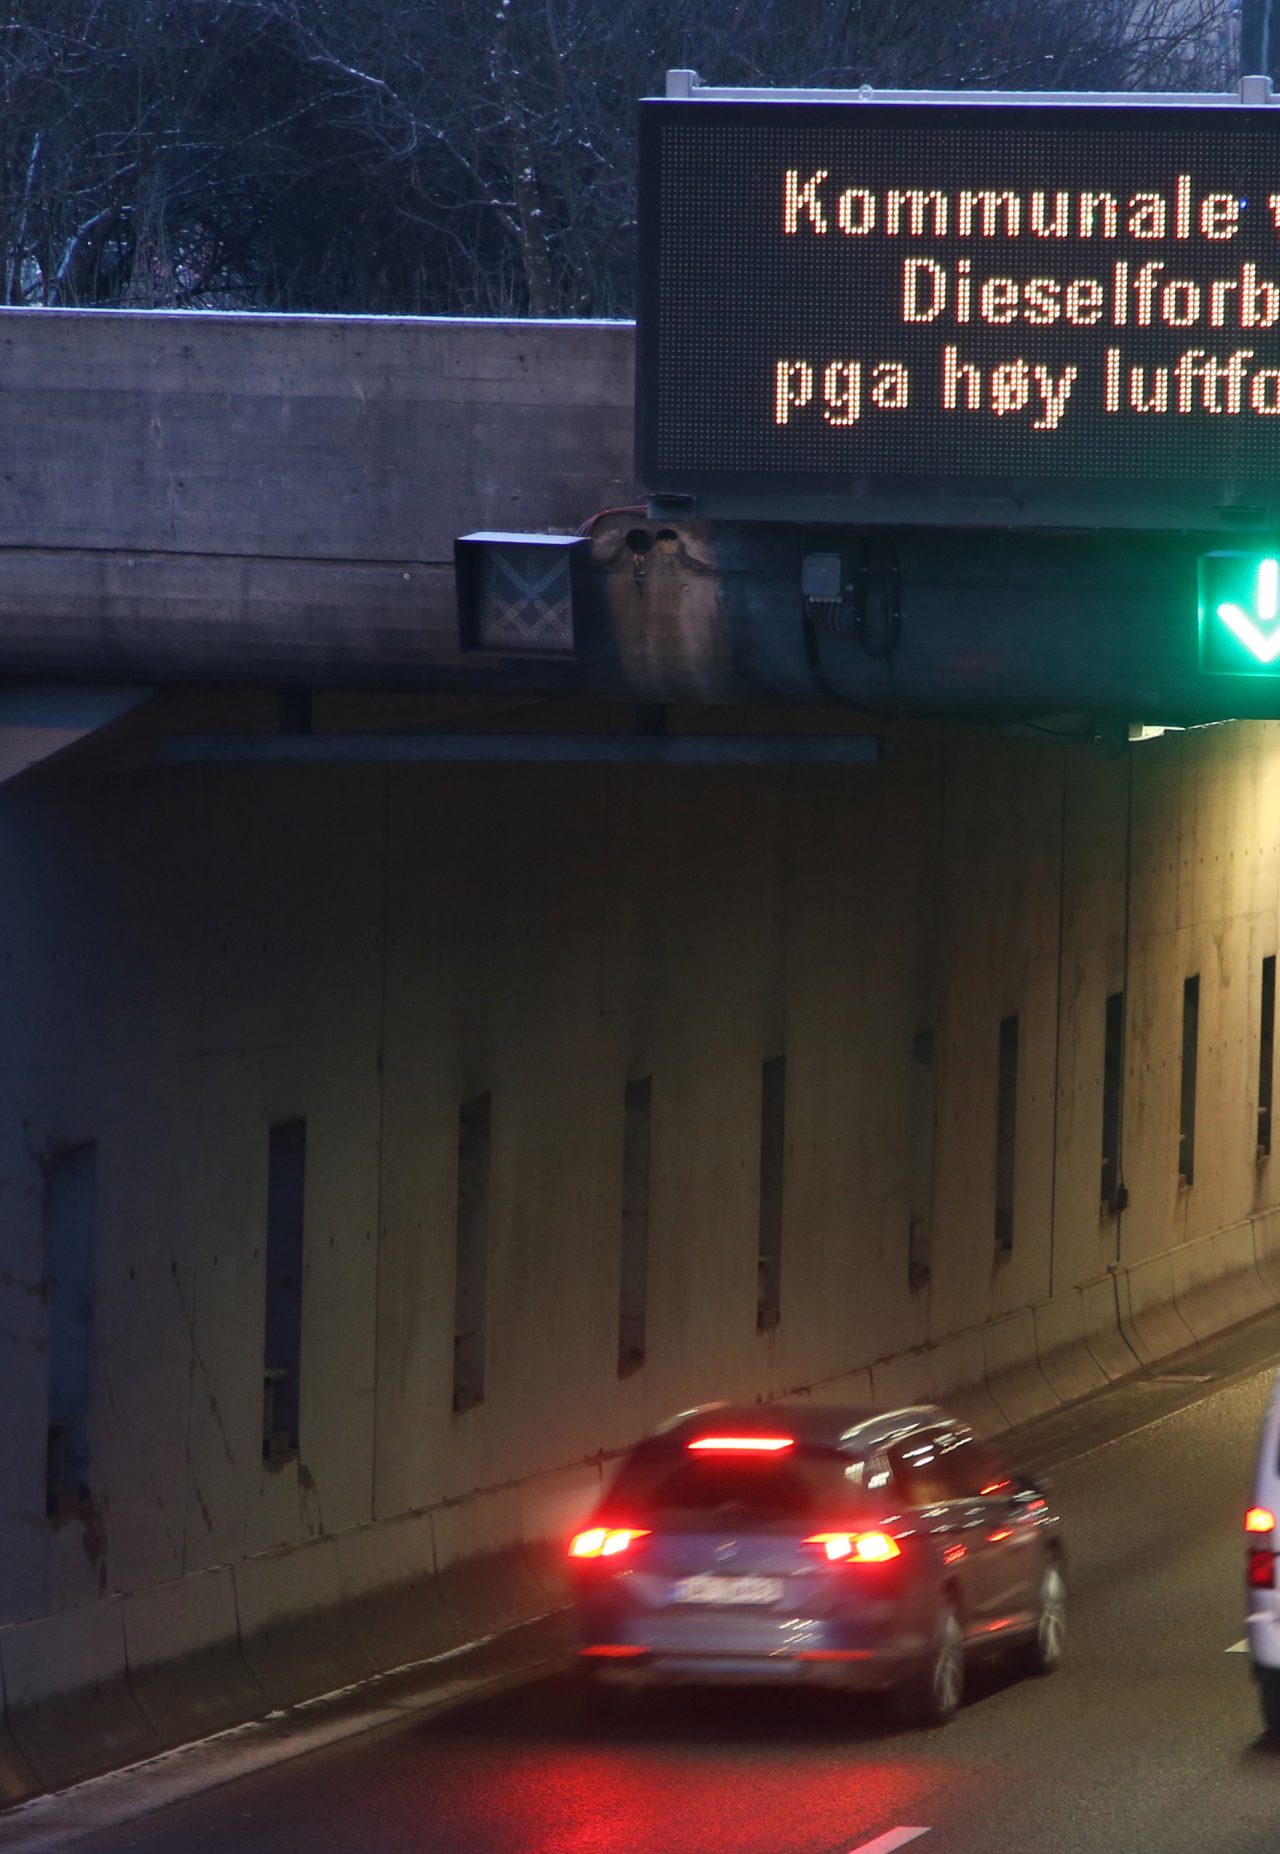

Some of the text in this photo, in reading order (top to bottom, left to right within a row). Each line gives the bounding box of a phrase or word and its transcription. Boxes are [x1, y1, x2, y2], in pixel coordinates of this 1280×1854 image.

[783, 169, 1240, 239] Kommunale
[774, 360, 909, 426] pga
[942, 345, 1078, 430] høy
